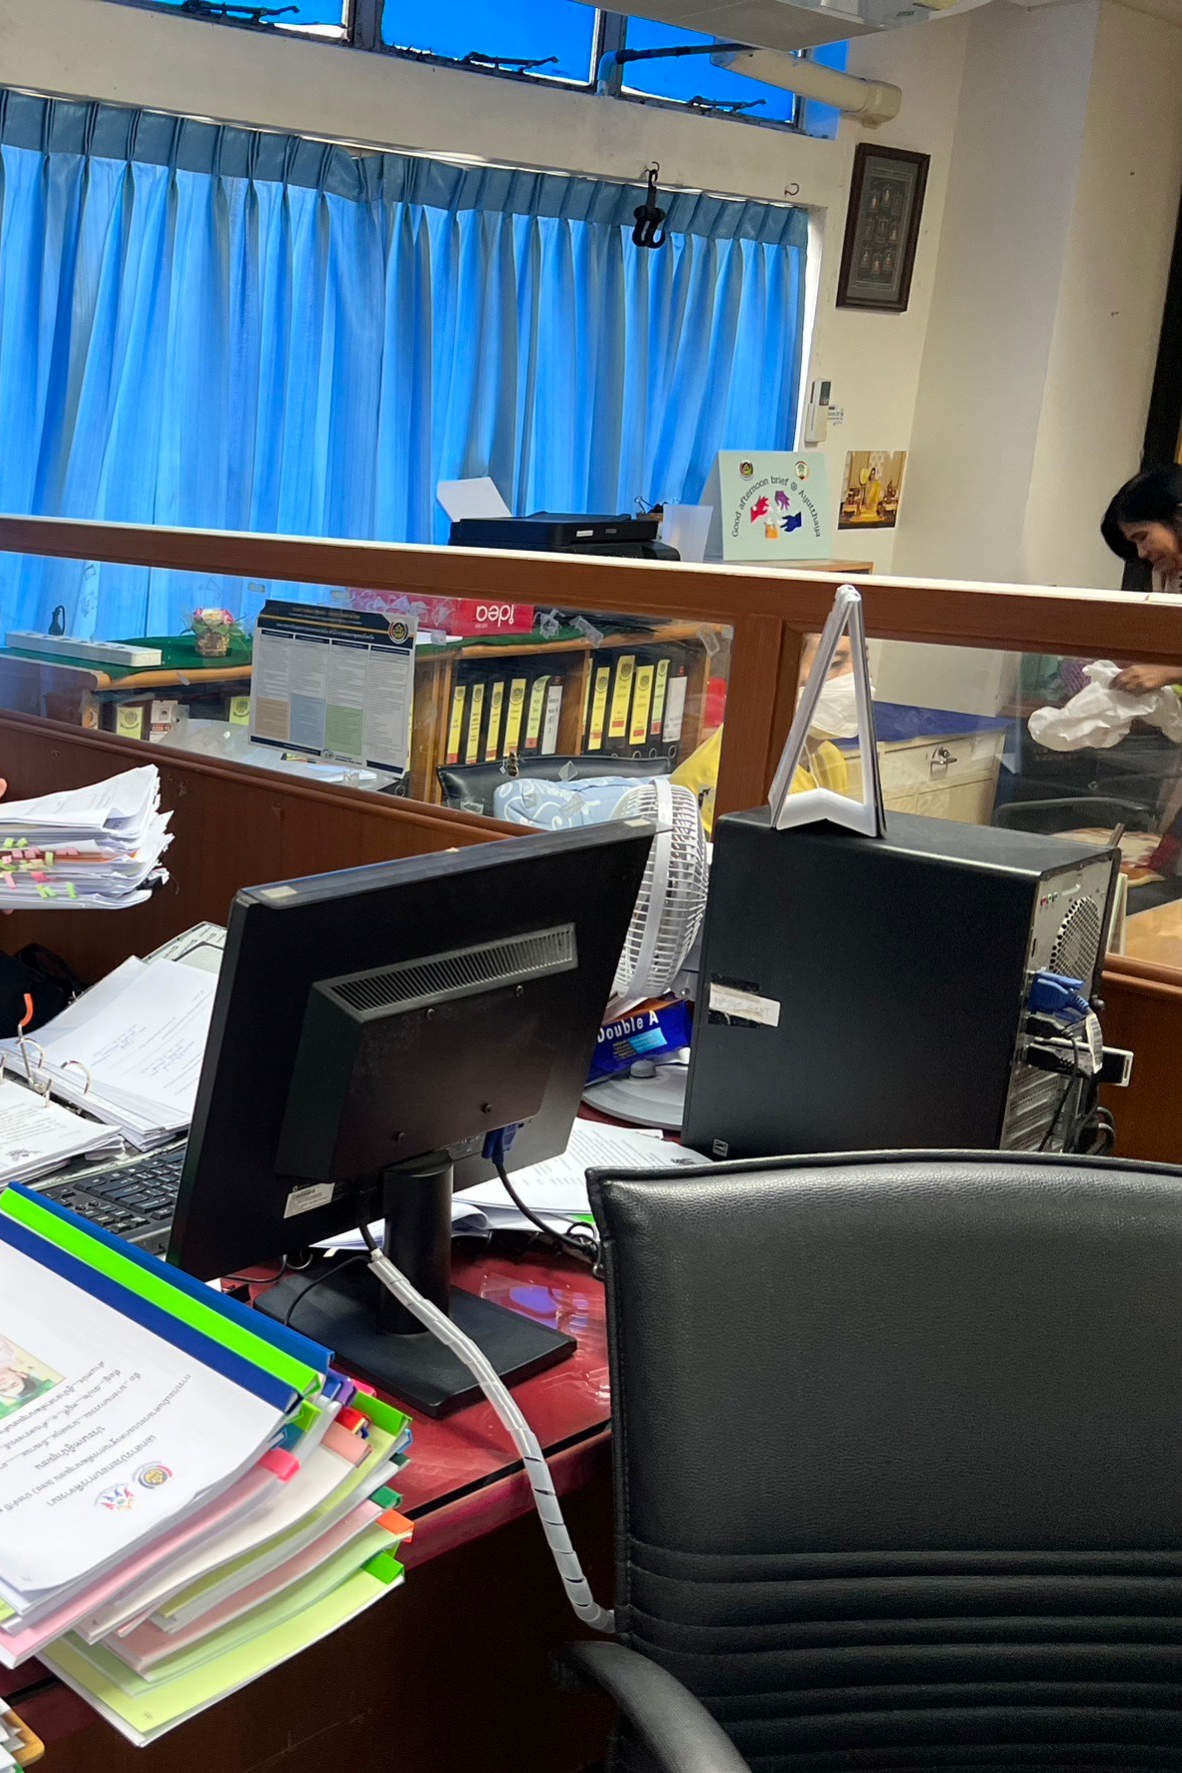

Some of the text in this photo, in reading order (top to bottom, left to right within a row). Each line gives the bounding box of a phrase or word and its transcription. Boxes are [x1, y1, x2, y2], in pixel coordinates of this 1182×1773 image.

[732, 476, 820, 537] Good afternoon brief @ Ayutthaya
[476, 604, 514, 628] idea
[649, 1010, 659, 1025] A
